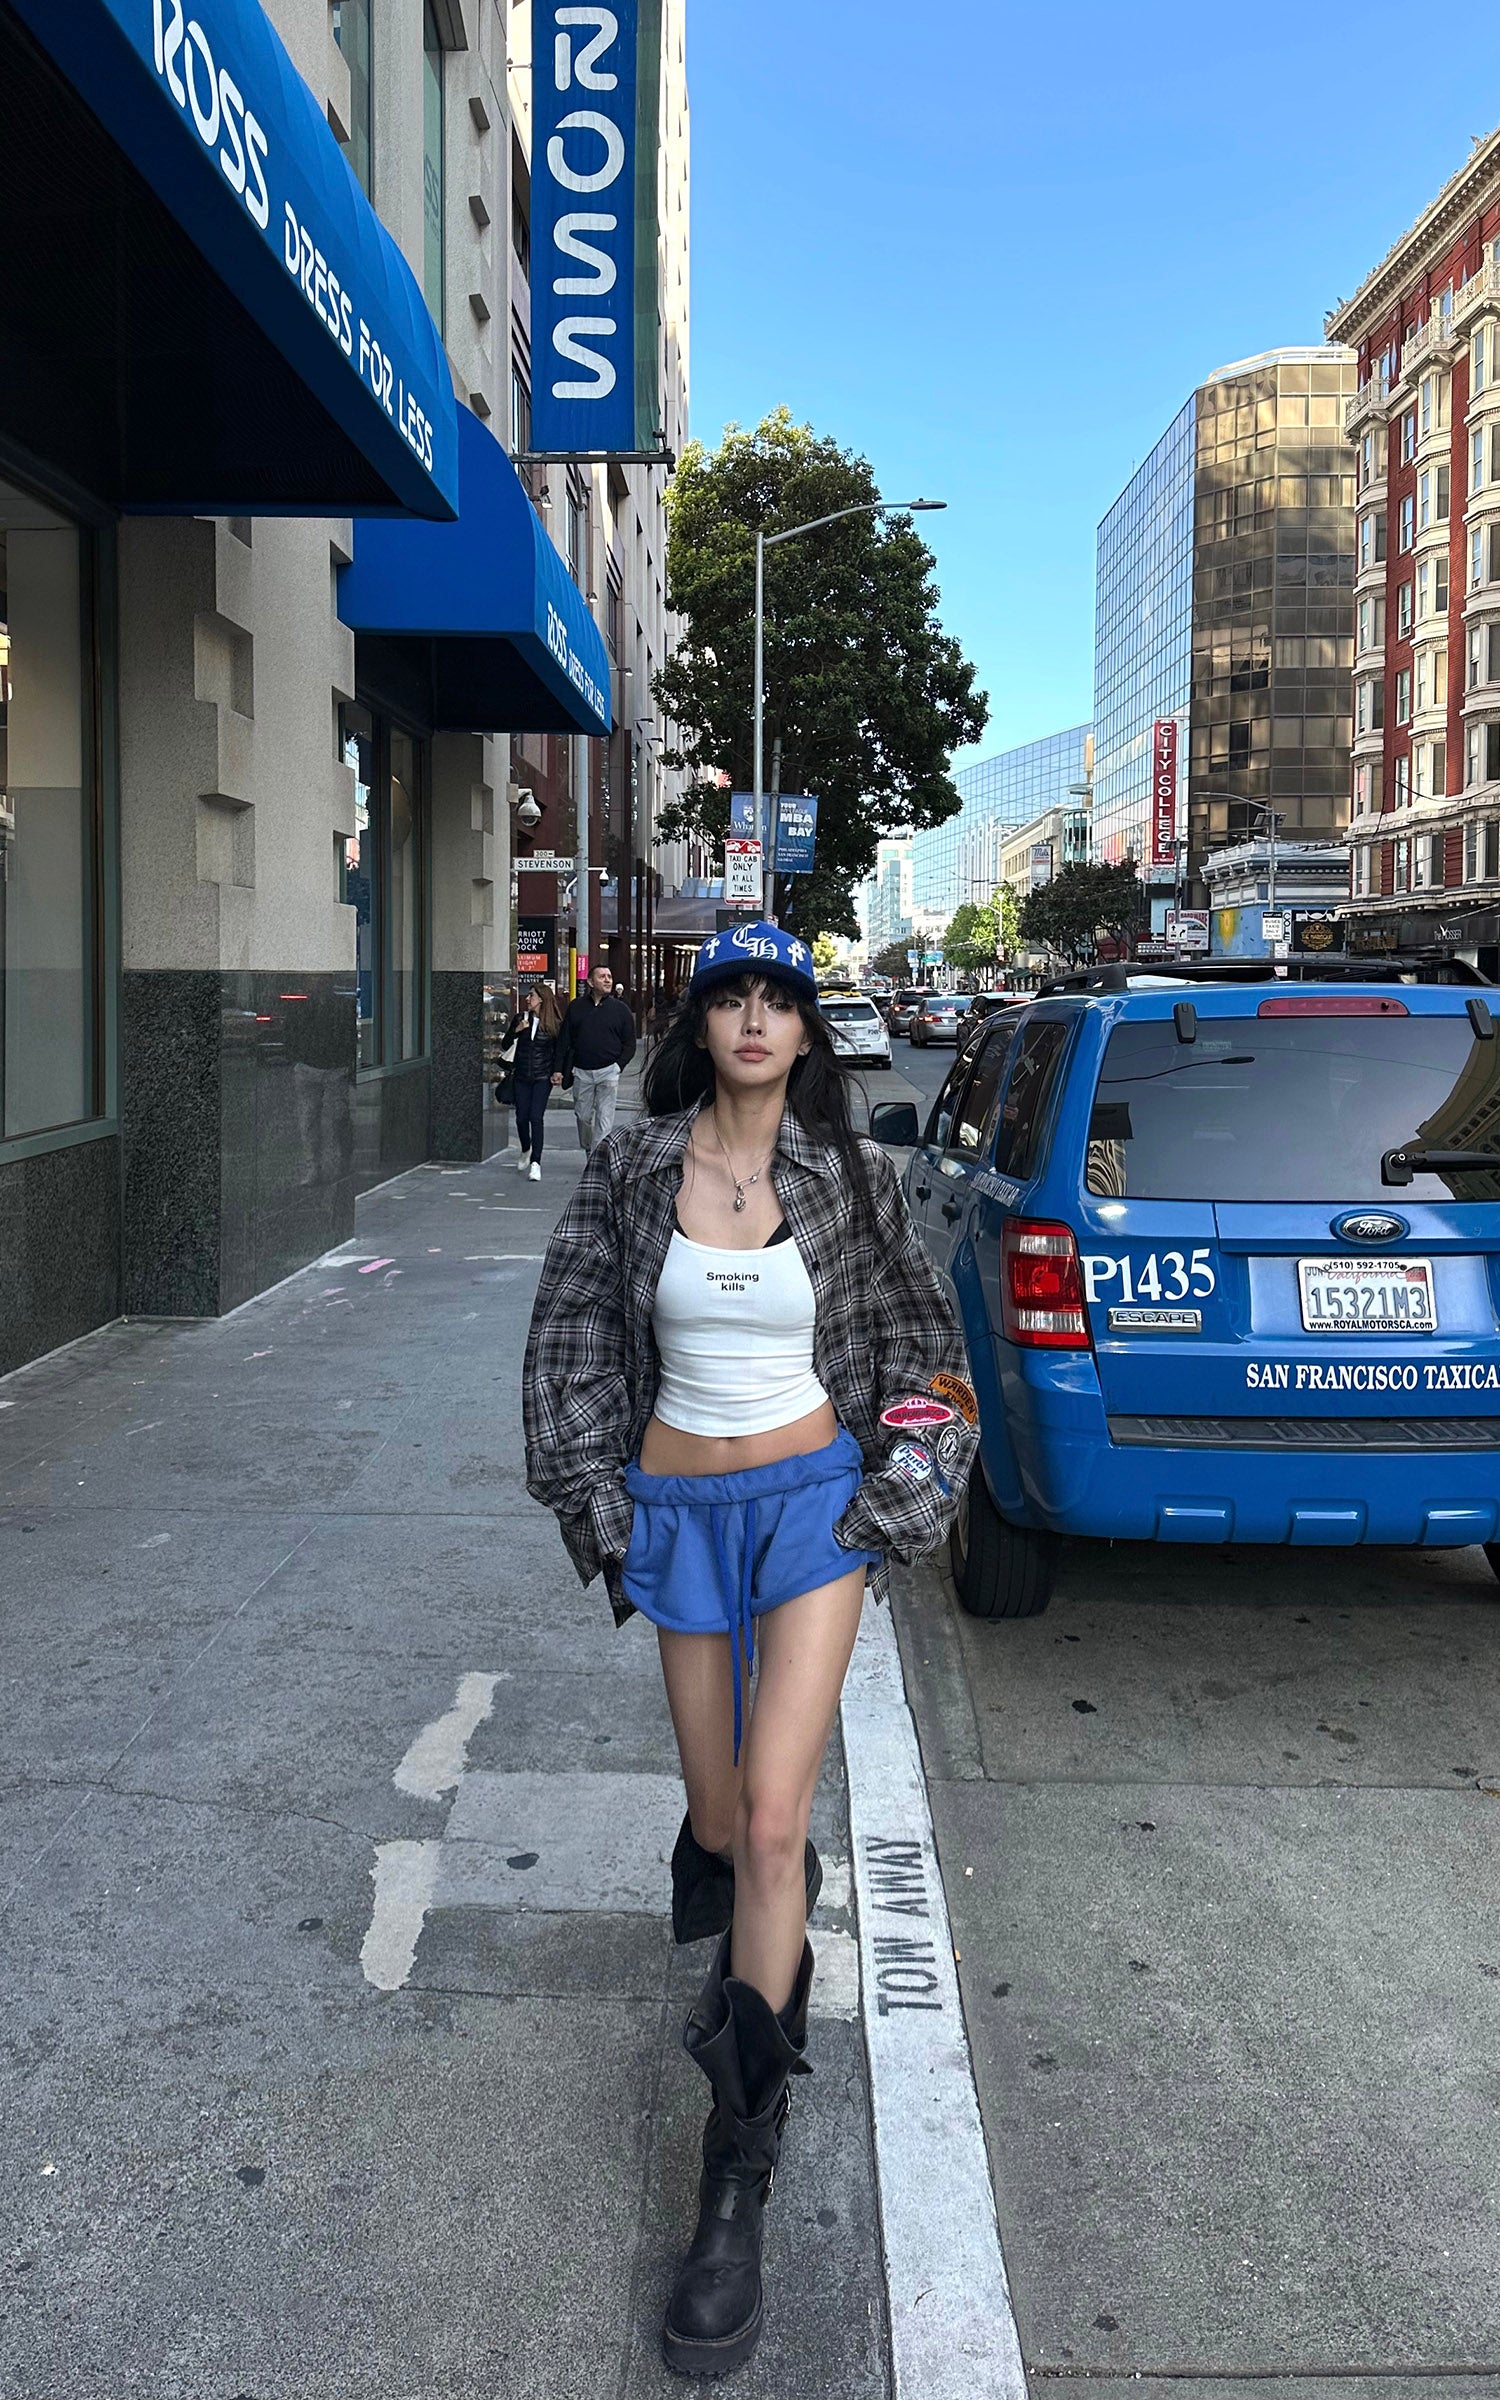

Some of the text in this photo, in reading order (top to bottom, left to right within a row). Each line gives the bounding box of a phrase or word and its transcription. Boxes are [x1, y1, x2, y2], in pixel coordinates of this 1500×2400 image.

[546, 6, 625, 399] ROSS
[153, 0, 433, 473] ROSS DRESS FOR LESS
[547, 600, 567, 670] ROSS
[1158, 725, 1172, 770] CITY
[780, 813, 814, 824] MBA
[1157, 775, 1173, 853] COLLEGE
[788, 826, 814, 837] BAY
[517, 859, 572, 868] STEVENSON
[732, 863, 753, 871] ONLY
[517, 930, 546, 938] RRIOTT
[1283, 912, 1291, 941] COLE
[1356, 1219, 1391, 1236] Ford
[1079, 1248, 1216, 1303] P1435
[1329, 1261, 1400, 1270] (510) 592-1705
[706, 1271, 760, 1283] Smoking
[721, 1282, 746, 1291] kills
[1310, 1286, 1427, 1319] 15321M3
[1115, 1312, 1196, 1324] ESCAPE
[1309, 1319, 1433, 1330] www.ROYALMOTORSCA.com
[1246, 1363, 1500, 1390] SAN FRANCISCO TAXICA
[938, 1377, 975, 1415] WARDEN
[865, 1836, 943, 2017] TOW AWAY
